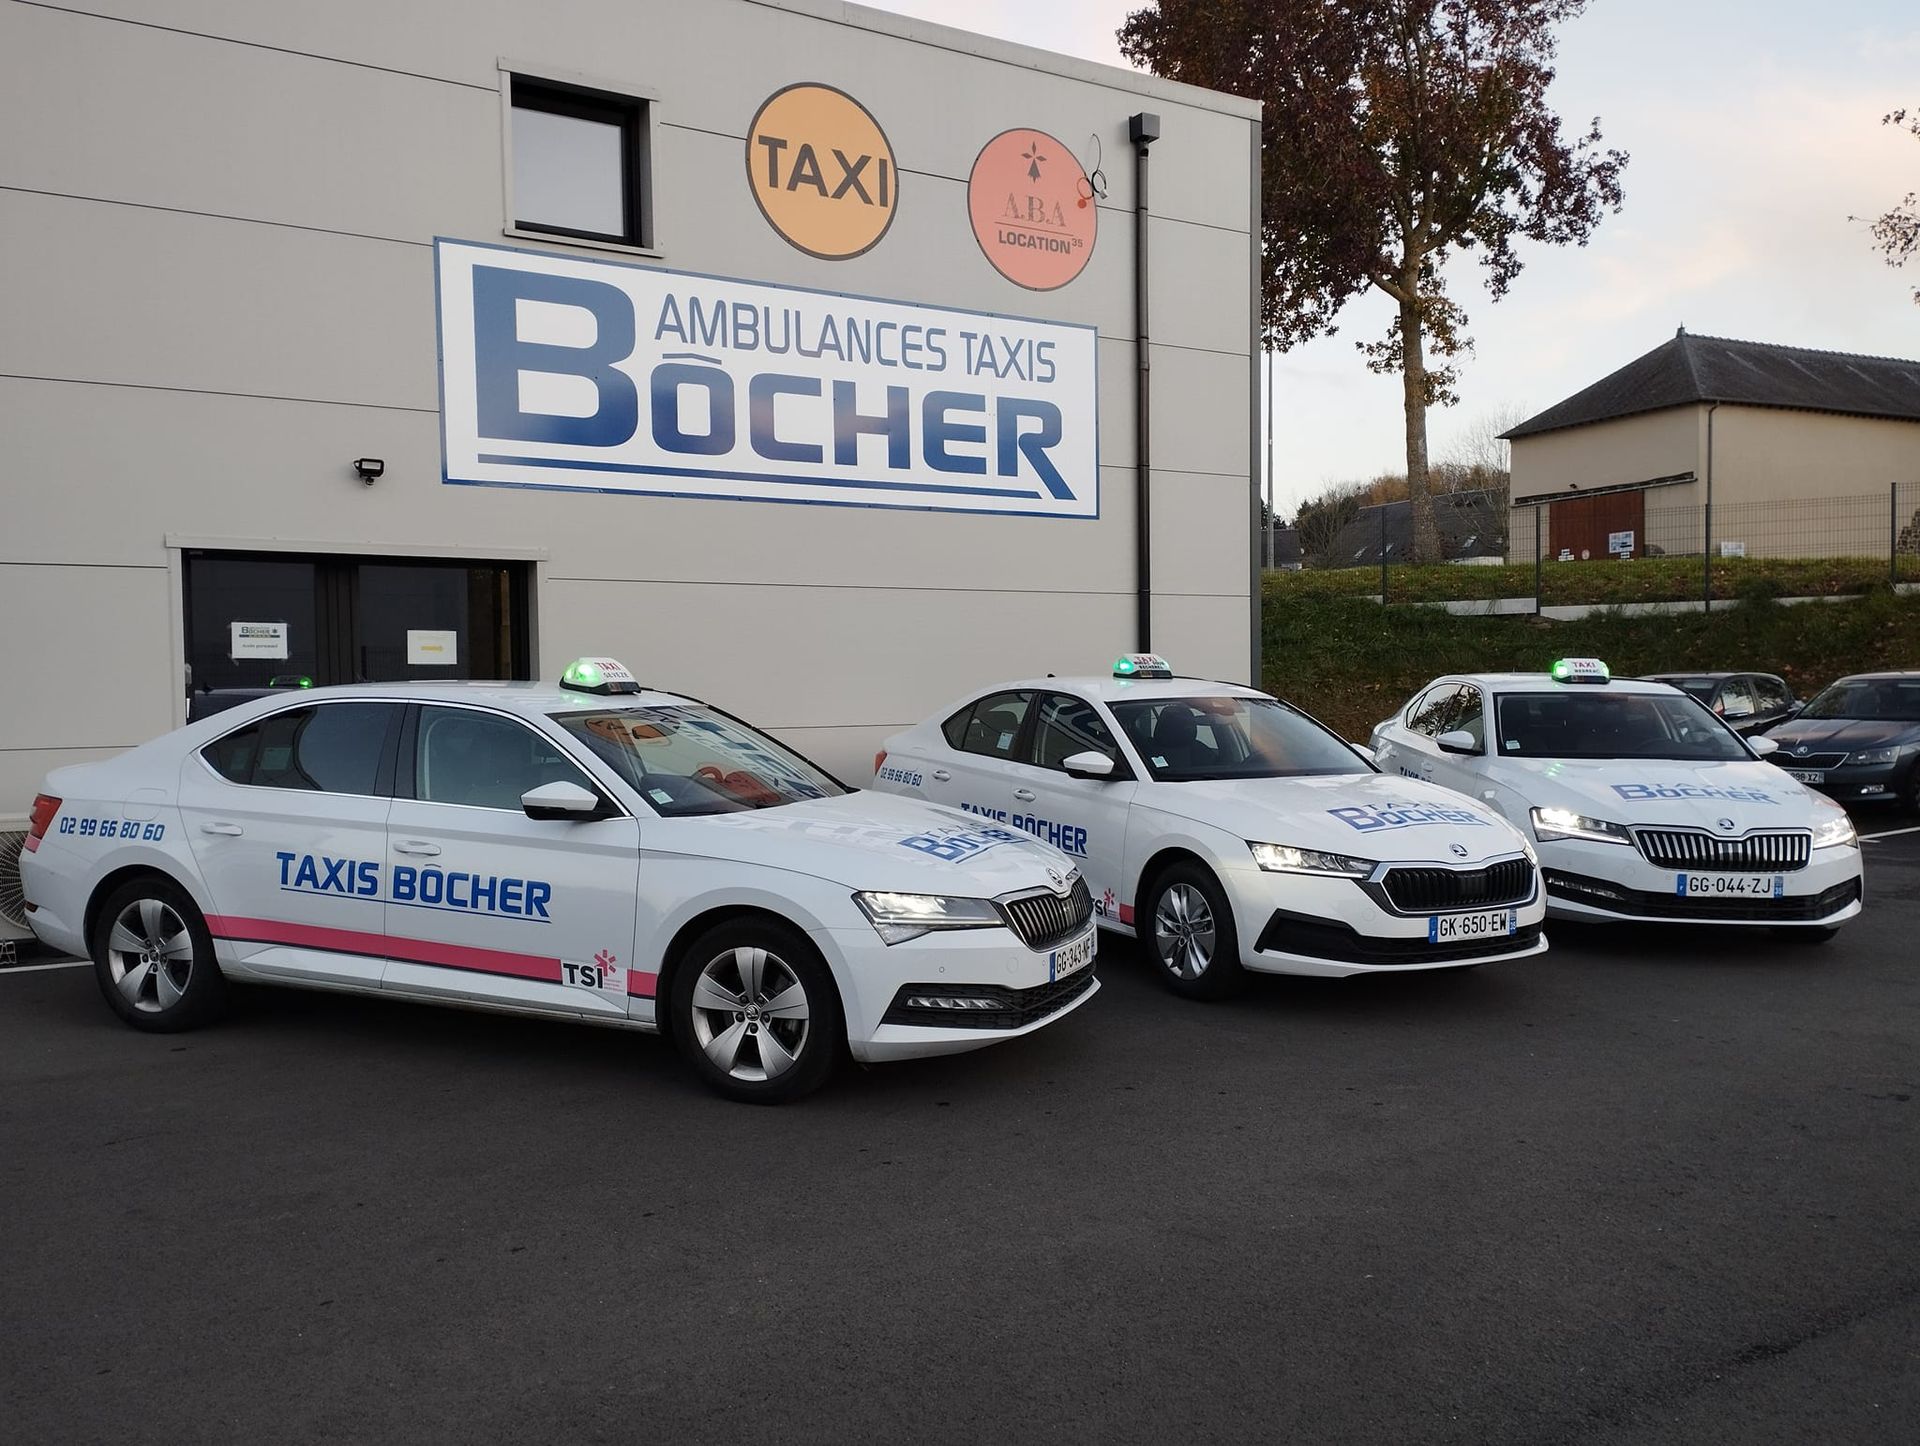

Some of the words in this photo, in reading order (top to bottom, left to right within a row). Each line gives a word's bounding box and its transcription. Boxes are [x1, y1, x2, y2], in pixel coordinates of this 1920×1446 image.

[758, 135, 888, 208] TAXI
[998, 229, 1071, 254] LOCATION
[655, 292, 947, 372] AMBULANCES
[959, 330, 1056, 384] TAXIS
[472, 264, 1077, 500] BÔCHER
[594, 662, 621, 671] TAXI
[911, 774, 922, 786] 60
[60, 816, 77, 834] 02
[79, 818, 97, 836] 99
[99, 820, 118, 837] 66
[120, 821, 140, 839] 80
[142, 823, 165, 841] 60
[276, 851, 380, 897] TAXIS
[392, 863, 552, 918] BÔCHER
[1689, 877, 1771, 893] GG-044-ZJ
[1091, 897, 1108, 917] SI
[1440, 912, 1507, 937] GK-650-EW
[1056, 937, 1091, 974] GG-343-NF
[563, 962, 604, 989] TSI
